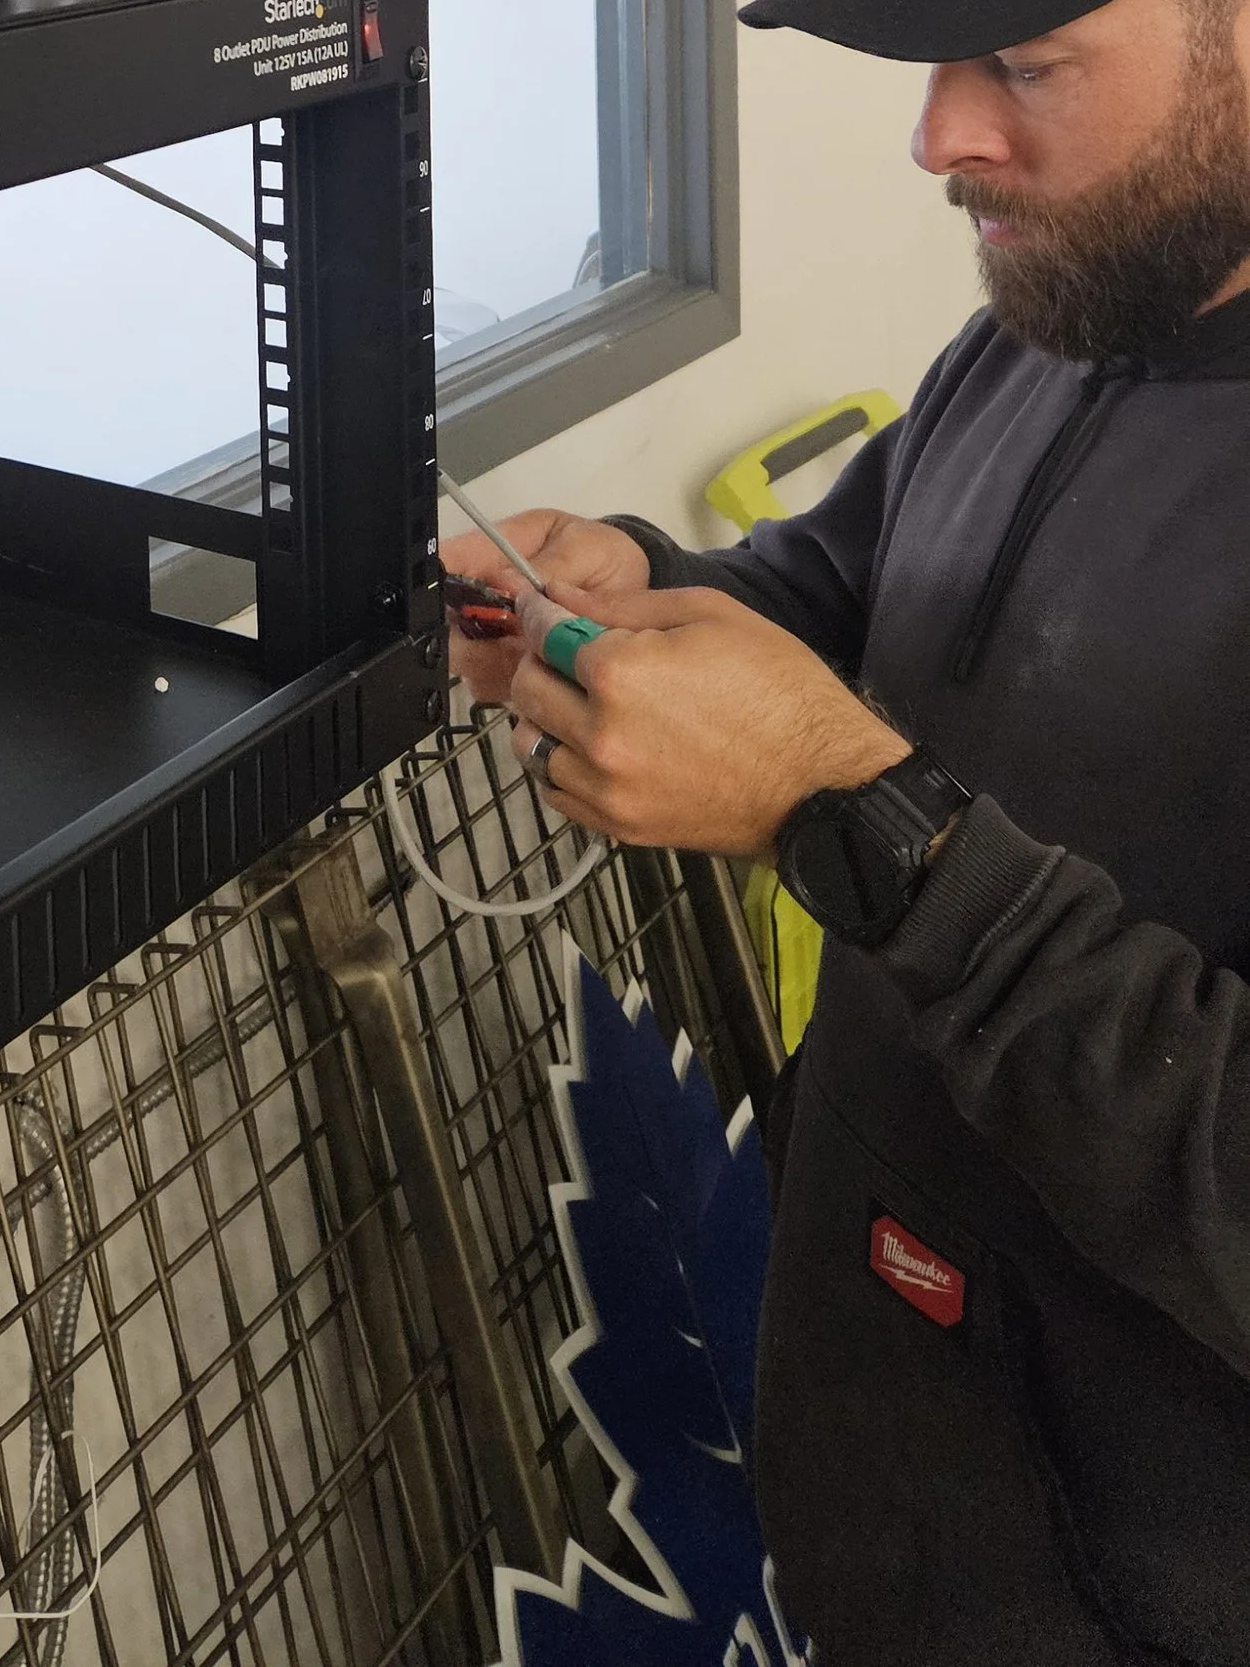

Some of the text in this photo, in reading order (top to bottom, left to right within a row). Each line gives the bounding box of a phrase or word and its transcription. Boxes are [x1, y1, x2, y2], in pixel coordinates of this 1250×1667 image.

[213, 21, 348, 63] 8 Outlet PDU Power Distribution
[254, 40, 349, 76] Unit 125V 15A (12A UL)
[290, 64, 349, 92] RKPW081915
[881, 1231, 952, 1287] Milwaukee
